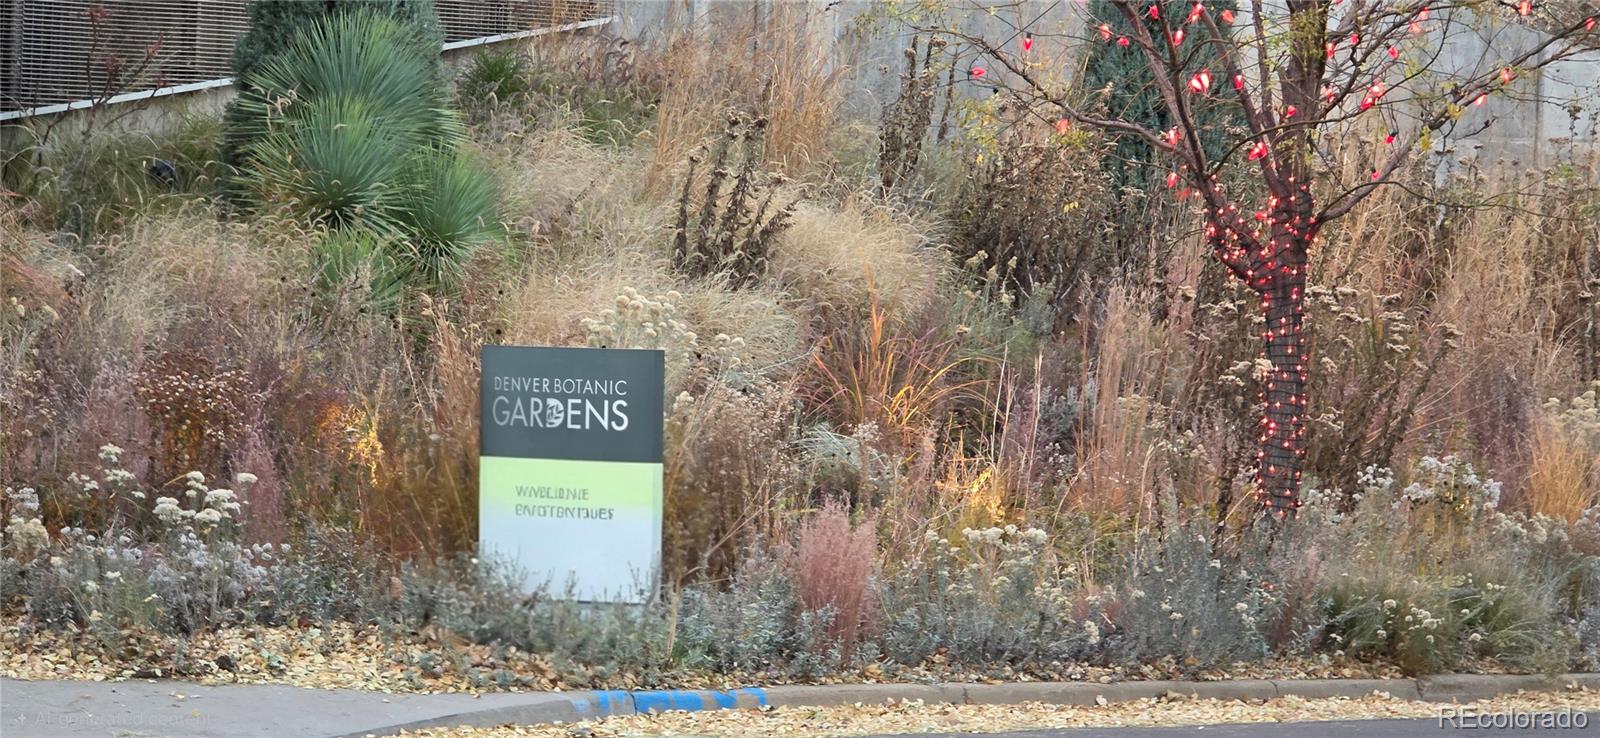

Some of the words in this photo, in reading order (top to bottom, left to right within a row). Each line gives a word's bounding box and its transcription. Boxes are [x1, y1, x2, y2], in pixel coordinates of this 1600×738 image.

[494, 376, 549, 393] DENVER
[554, 378, 628, 395] BOTANIC
[492, 395, 628, 431] GARDENS
